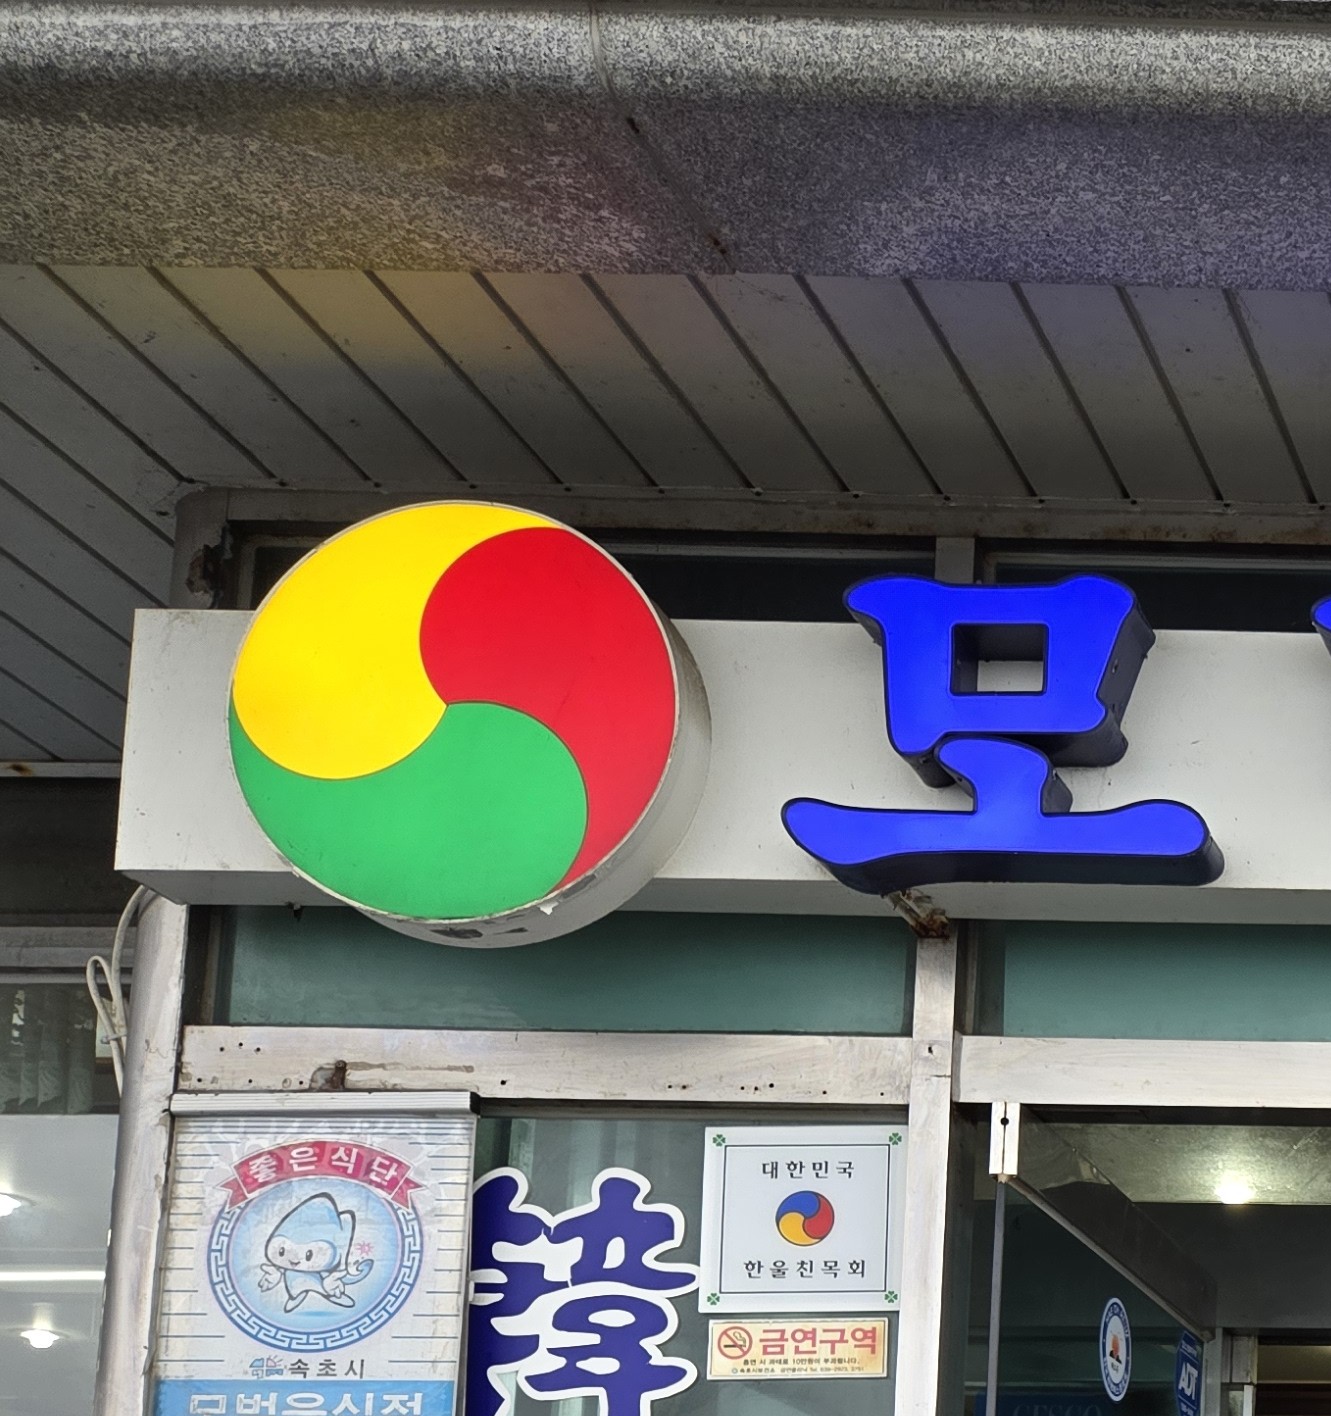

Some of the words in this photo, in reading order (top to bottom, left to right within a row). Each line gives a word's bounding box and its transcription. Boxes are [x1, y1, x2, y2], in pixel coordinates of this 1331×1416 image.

[248, 1145, 400, 1186] 좋은식단
[761, 1160, 855, 1180] 대한민국
[743, 1258, 866, 1279] 한울친목회
[759, 1327, 877, 1356] 금연구역
[288, 1358, 365, 1379] 속초시
